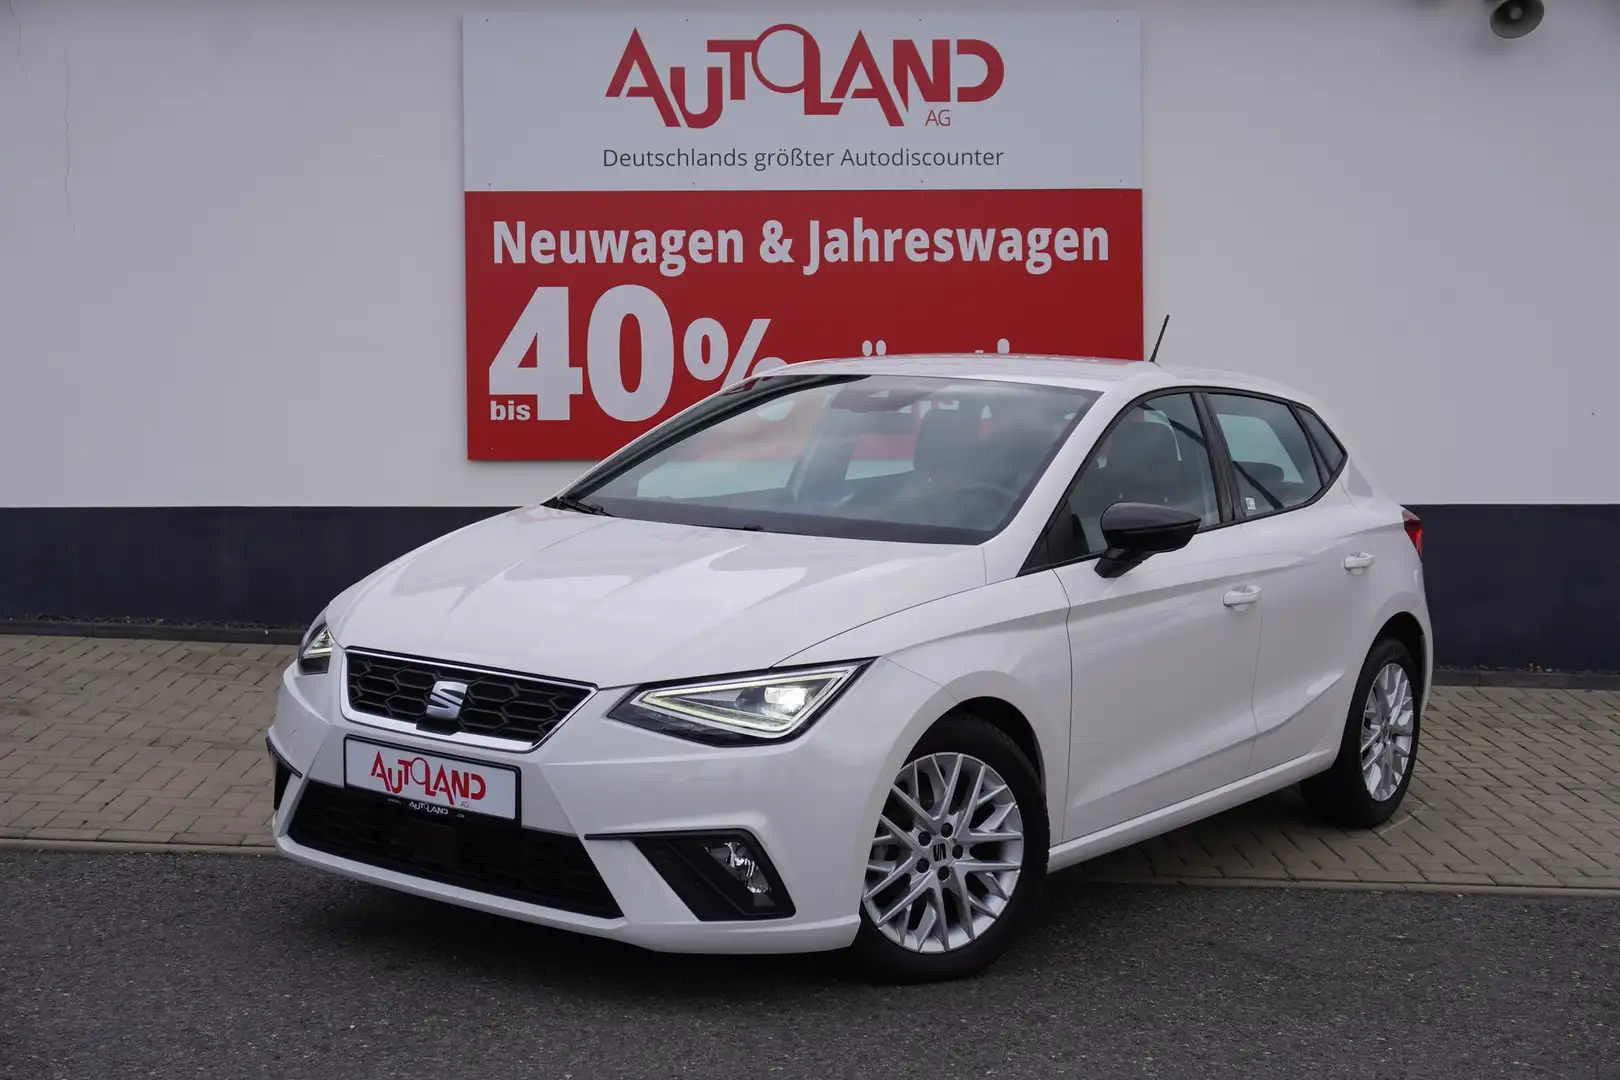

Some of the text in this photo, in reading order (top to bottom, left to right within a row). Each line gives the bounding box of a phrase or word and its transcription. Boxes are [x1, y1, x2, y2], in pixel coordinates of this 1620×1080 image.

[605, 23, 1004, 128] AUTOLAND
[925, 109, 952, 128] AG
[603, 147, 1004, 171] Deutschlands größter Autodiscounter
[493, 217, 1109, 277] Neuwagen & Jahreswagen
[490, 401, 531, 421] bis
[370, 751, 487, 805] AUTOLAND
